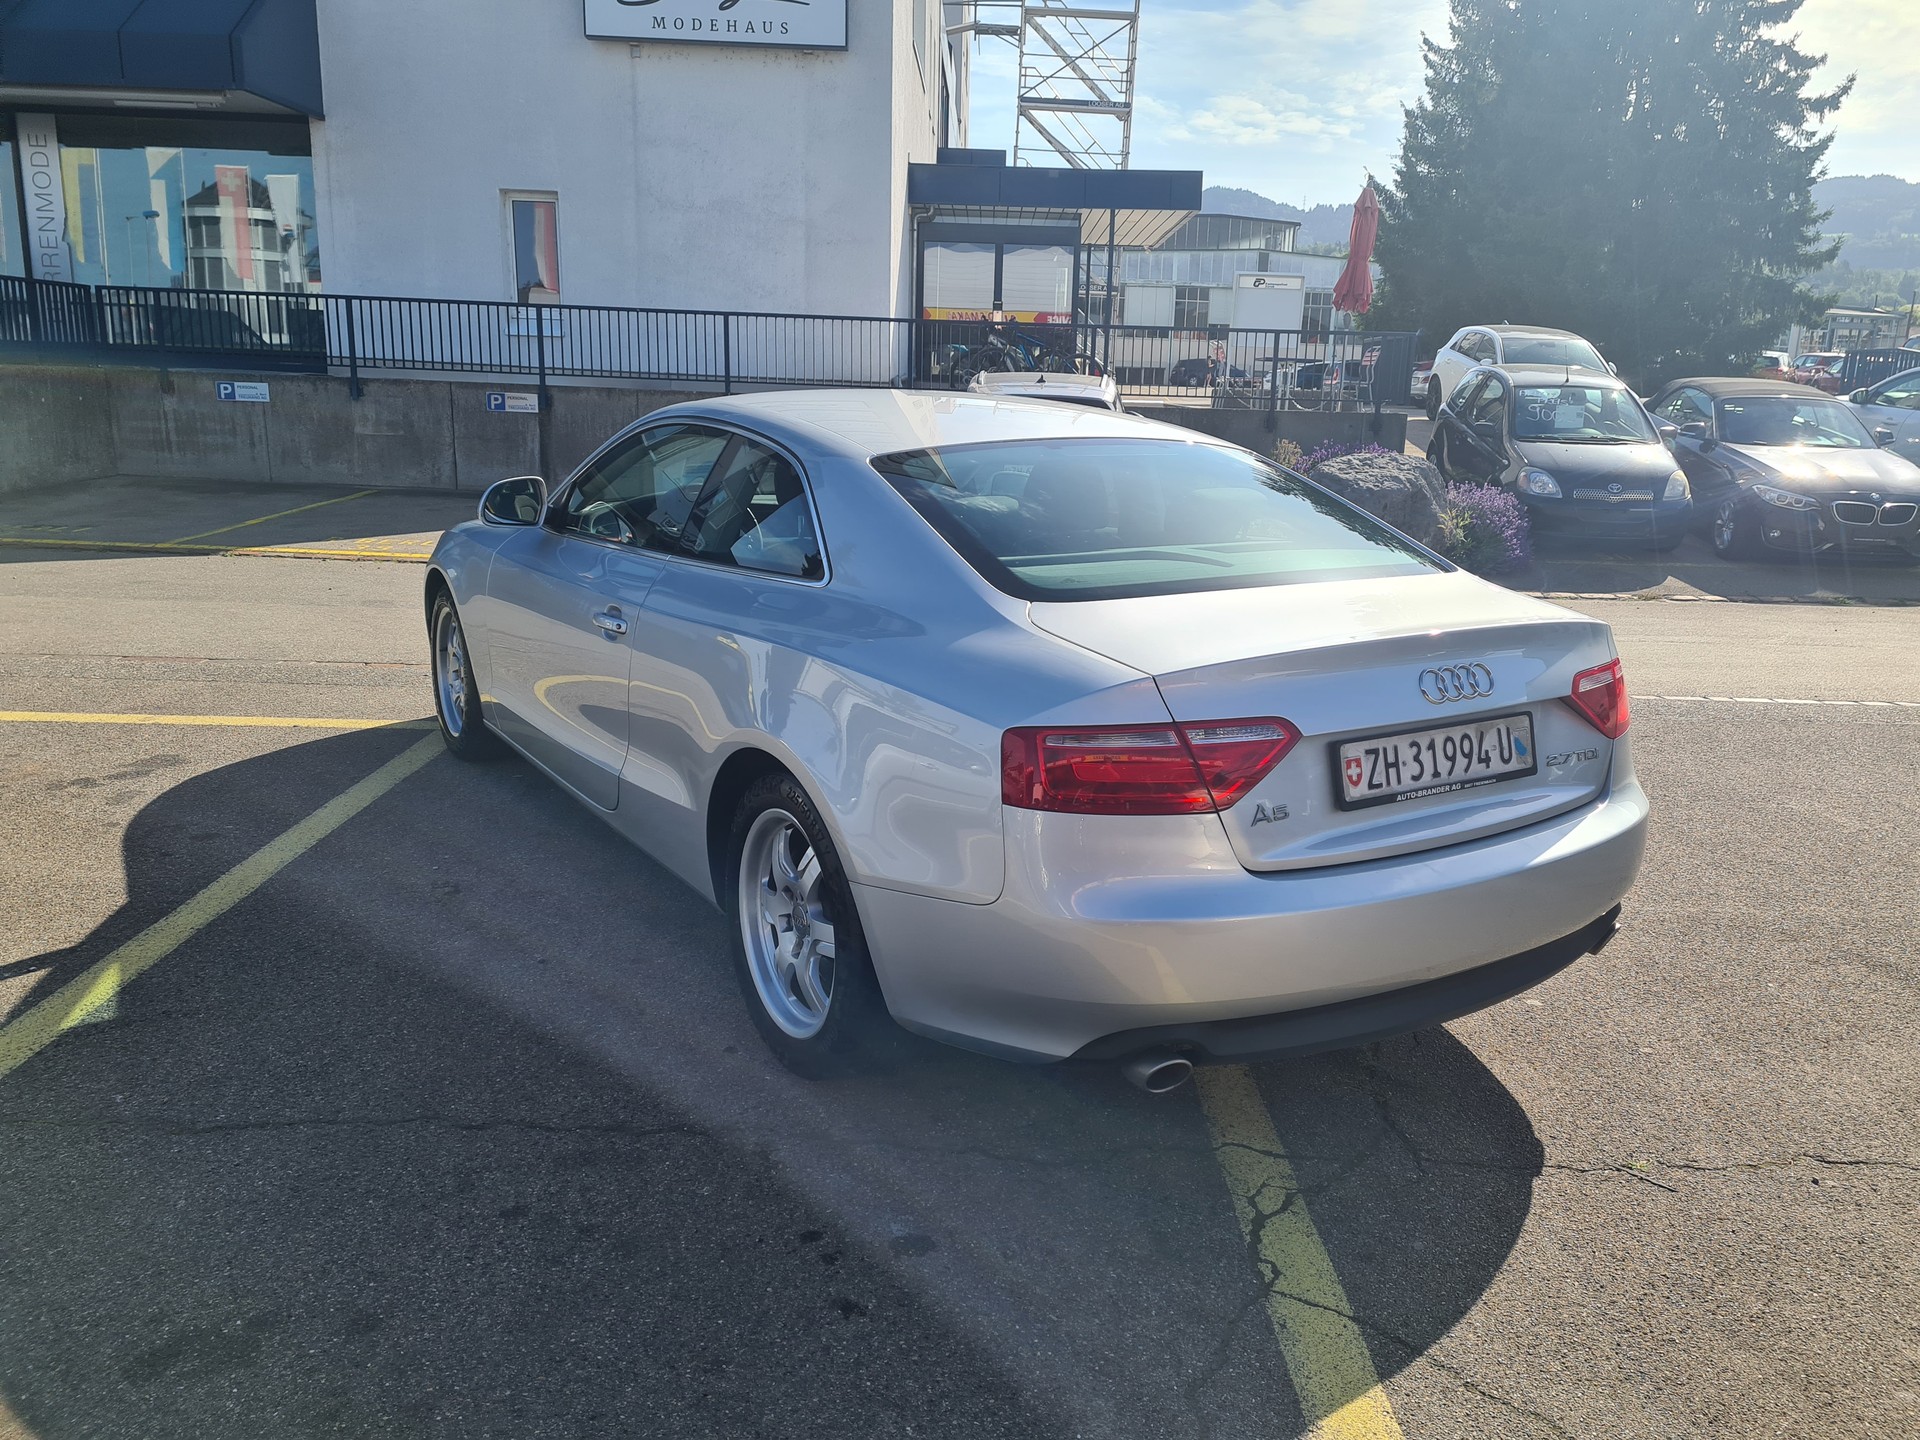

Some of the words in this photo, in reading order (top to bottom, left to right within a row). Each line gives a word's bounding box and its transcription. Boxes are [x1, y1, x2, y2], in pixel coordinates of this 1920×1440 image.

[651, 16, 789, 35] MODEHAUS
[1396, 784, 1450, 802] AUTO-BRANDER
[1451, 783, 1461, 791] AG
[1250, 802, 1290, 828] A5
